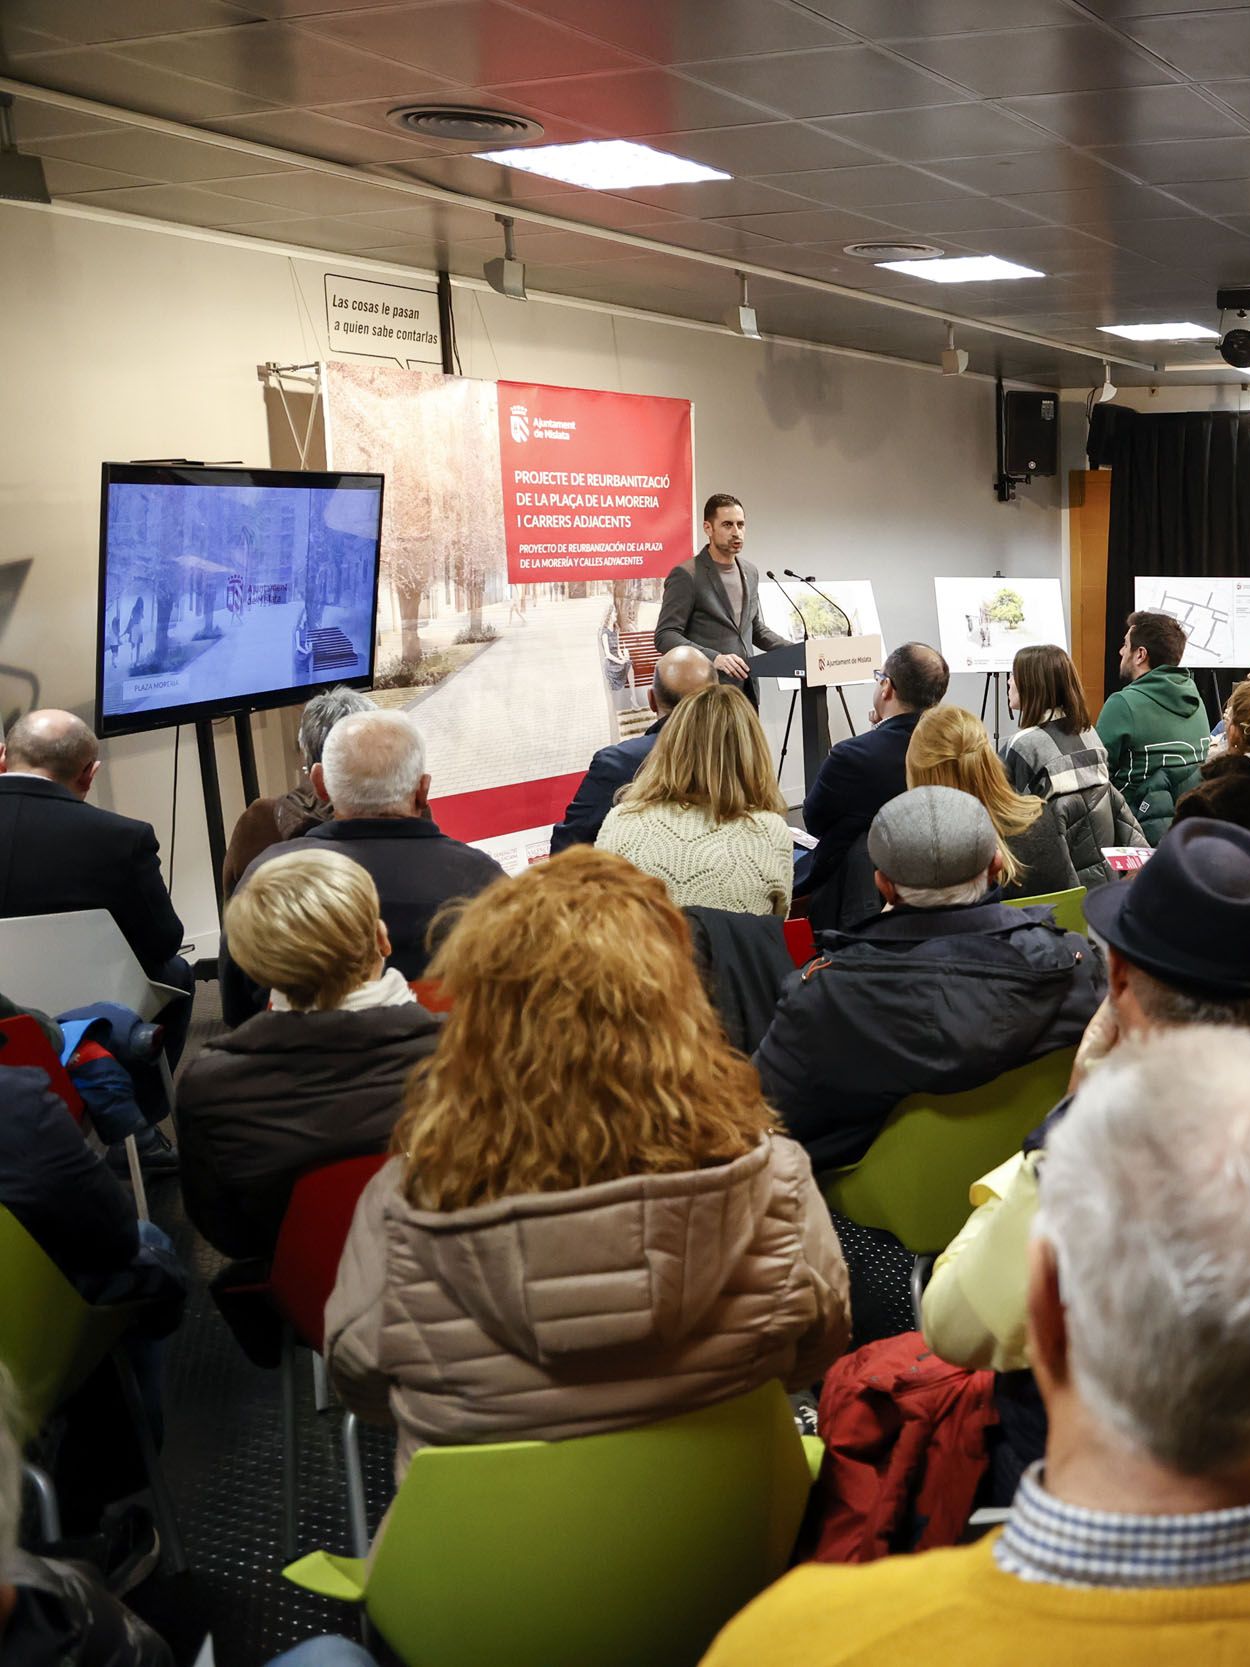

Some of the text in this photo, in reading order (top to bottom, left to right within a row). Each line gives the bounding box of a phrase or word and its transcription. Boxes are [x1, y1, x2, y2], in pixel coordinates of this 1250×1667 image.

[332, 294, 420, 320] Las cosas le pasan
[334, 320, 438, 345] a quien sabe contarlas
[533, 417, 576, 430] Ajuntament
[533, 429, 543, 439] de
[514, 470, 670, 489] PROJECTE DE REURBANITZACIÓ
[516, 492, 659, 509] DE LA PLAÇA DE LA MORERIA
[517, 514, 631, 528] I CARRERS ADJACENTS
[519, 541, 663, 554] PROYECTO DE REURBANIZACIÓN DE LA PLAZA
[520, 556, 643, 568] DE LA MORERÍA Y CALLES ADYACENTES
[826, 658, 851, 668] Ajuntament
[857, 656, 872, 664] Mislata
